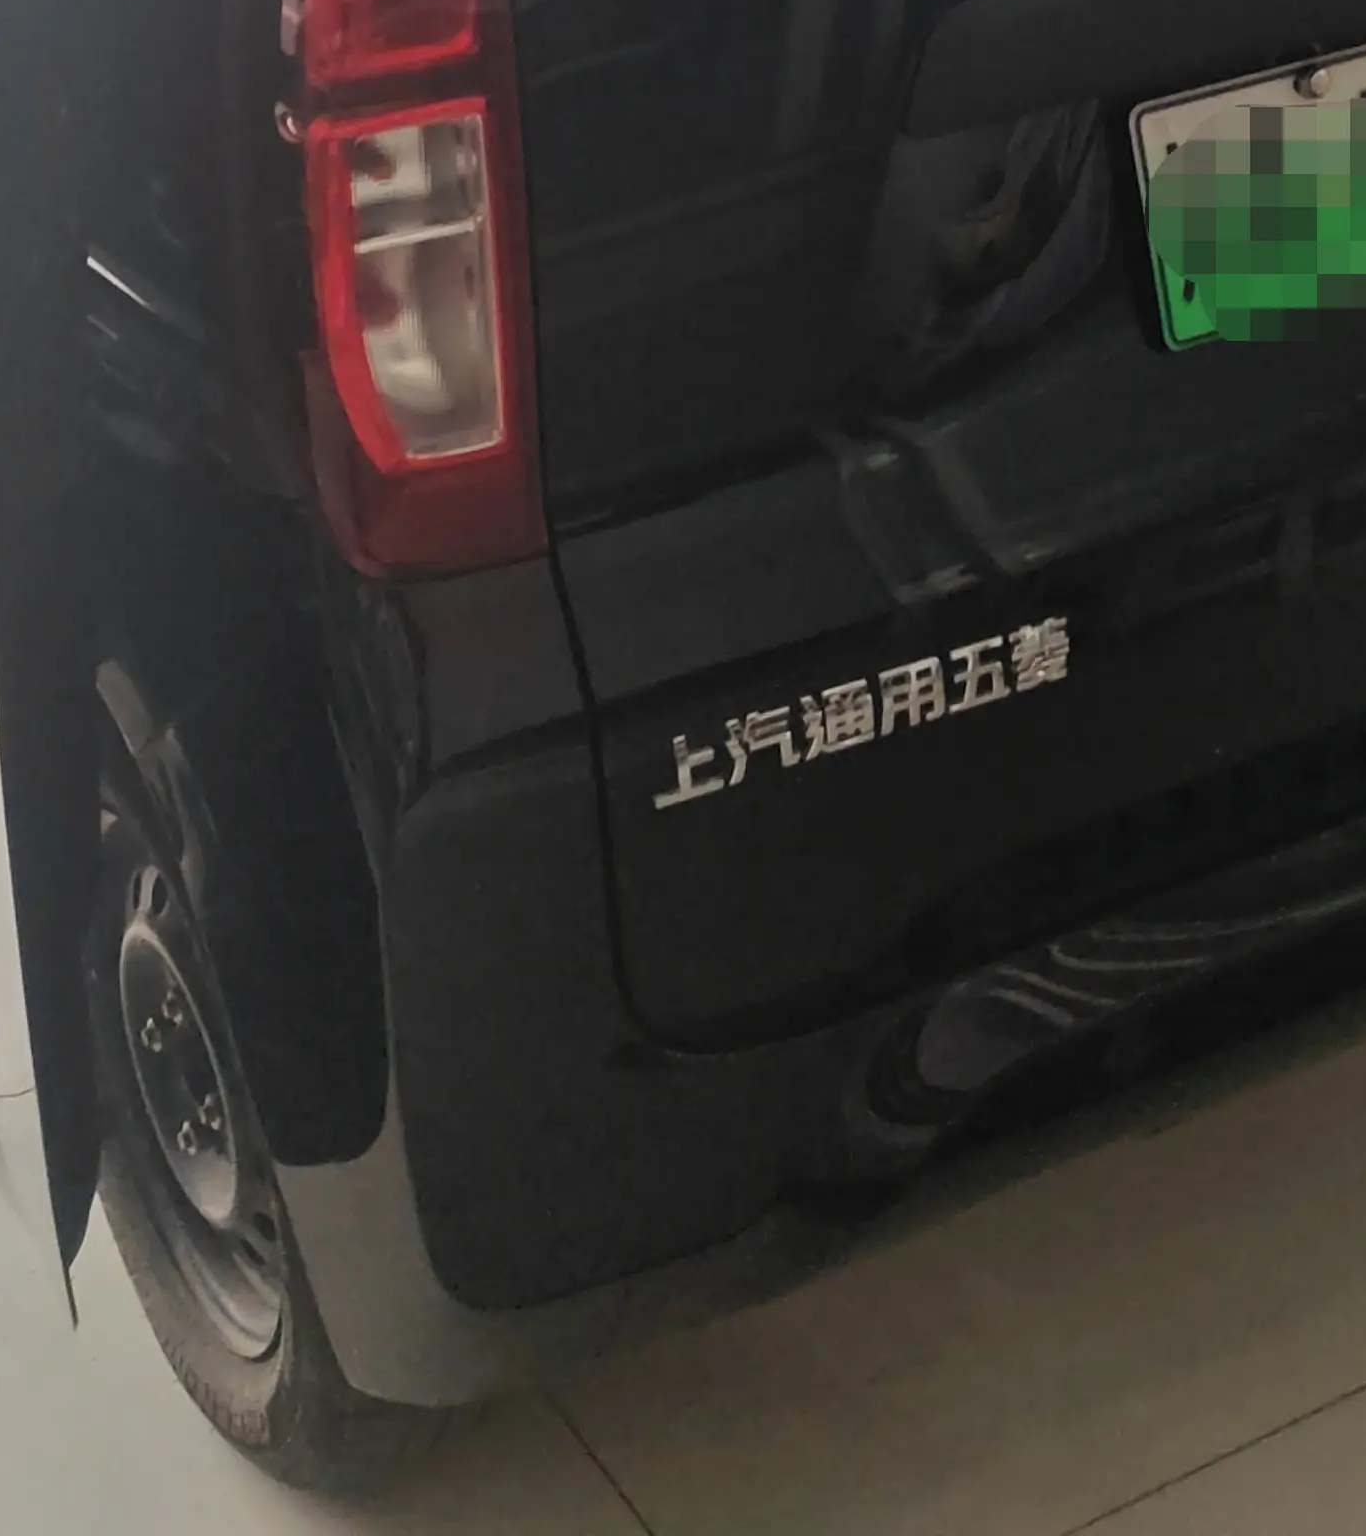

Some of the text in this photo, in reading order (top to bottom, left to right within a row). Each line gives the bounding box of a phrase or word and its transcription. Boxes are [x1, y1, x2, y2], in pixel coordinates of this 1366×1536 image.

[653, 616, 1071, 810] 上汽通用五菱
